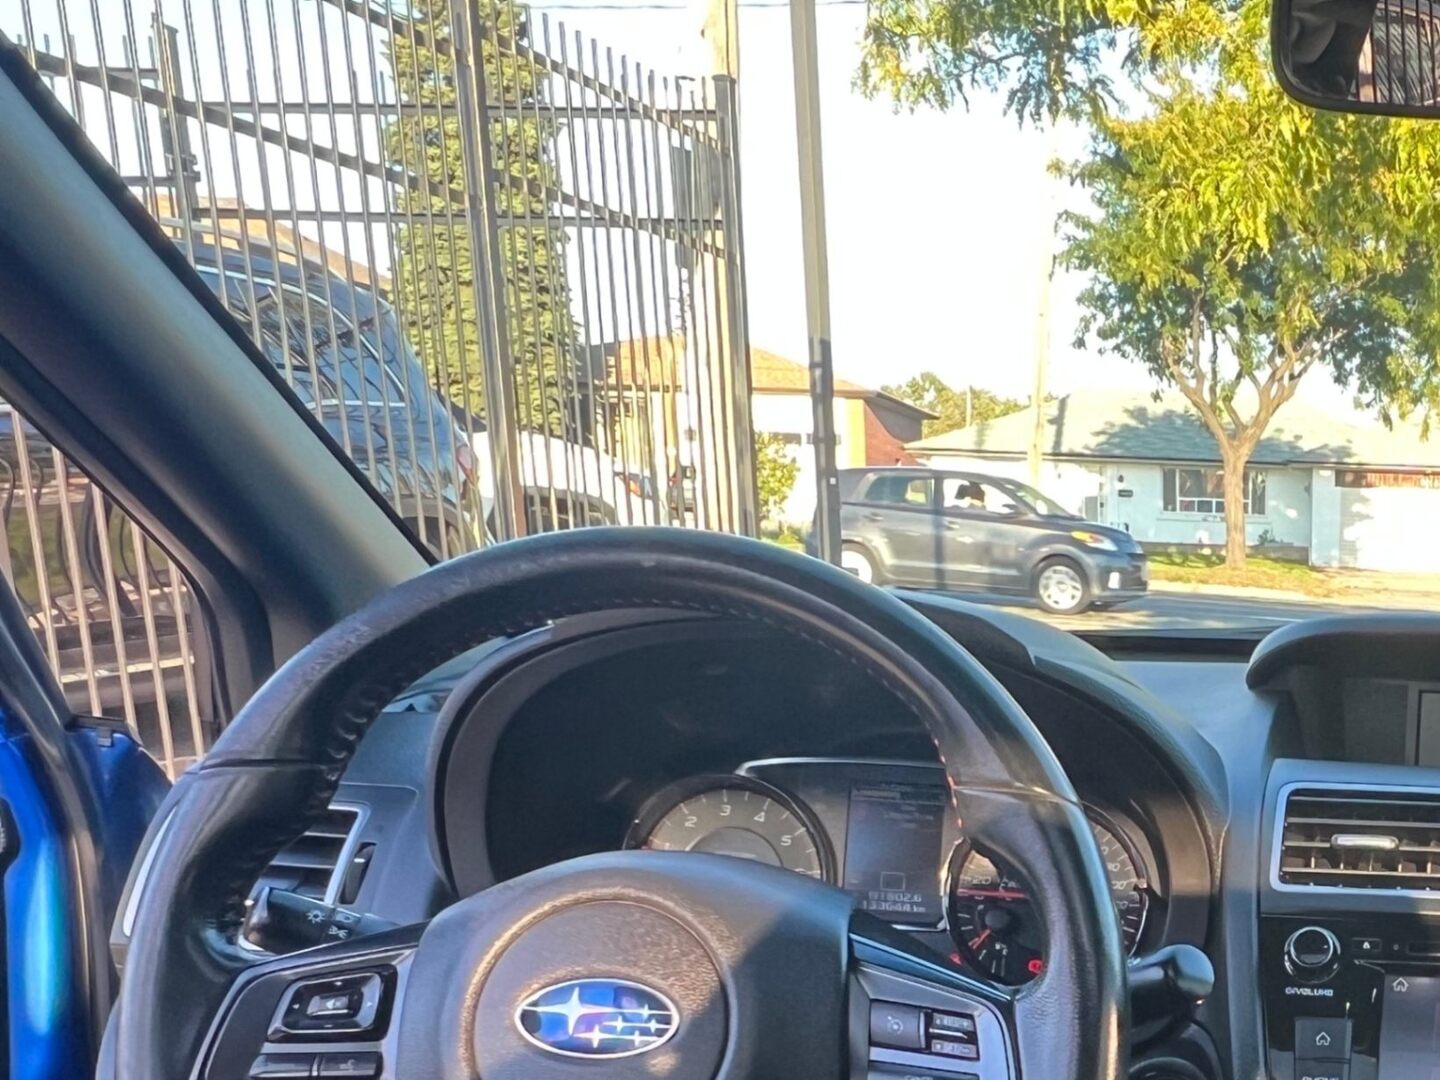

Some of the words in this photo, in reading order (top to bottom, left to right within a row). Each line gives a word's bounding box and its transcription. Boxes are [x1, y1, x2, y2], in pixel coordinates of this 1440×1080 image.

[719, 804, 732, 816] 3
[684, 815, 698, 828] 2
[753, 811, 765, 823] 4
[780, 835, 793, 847] 5
